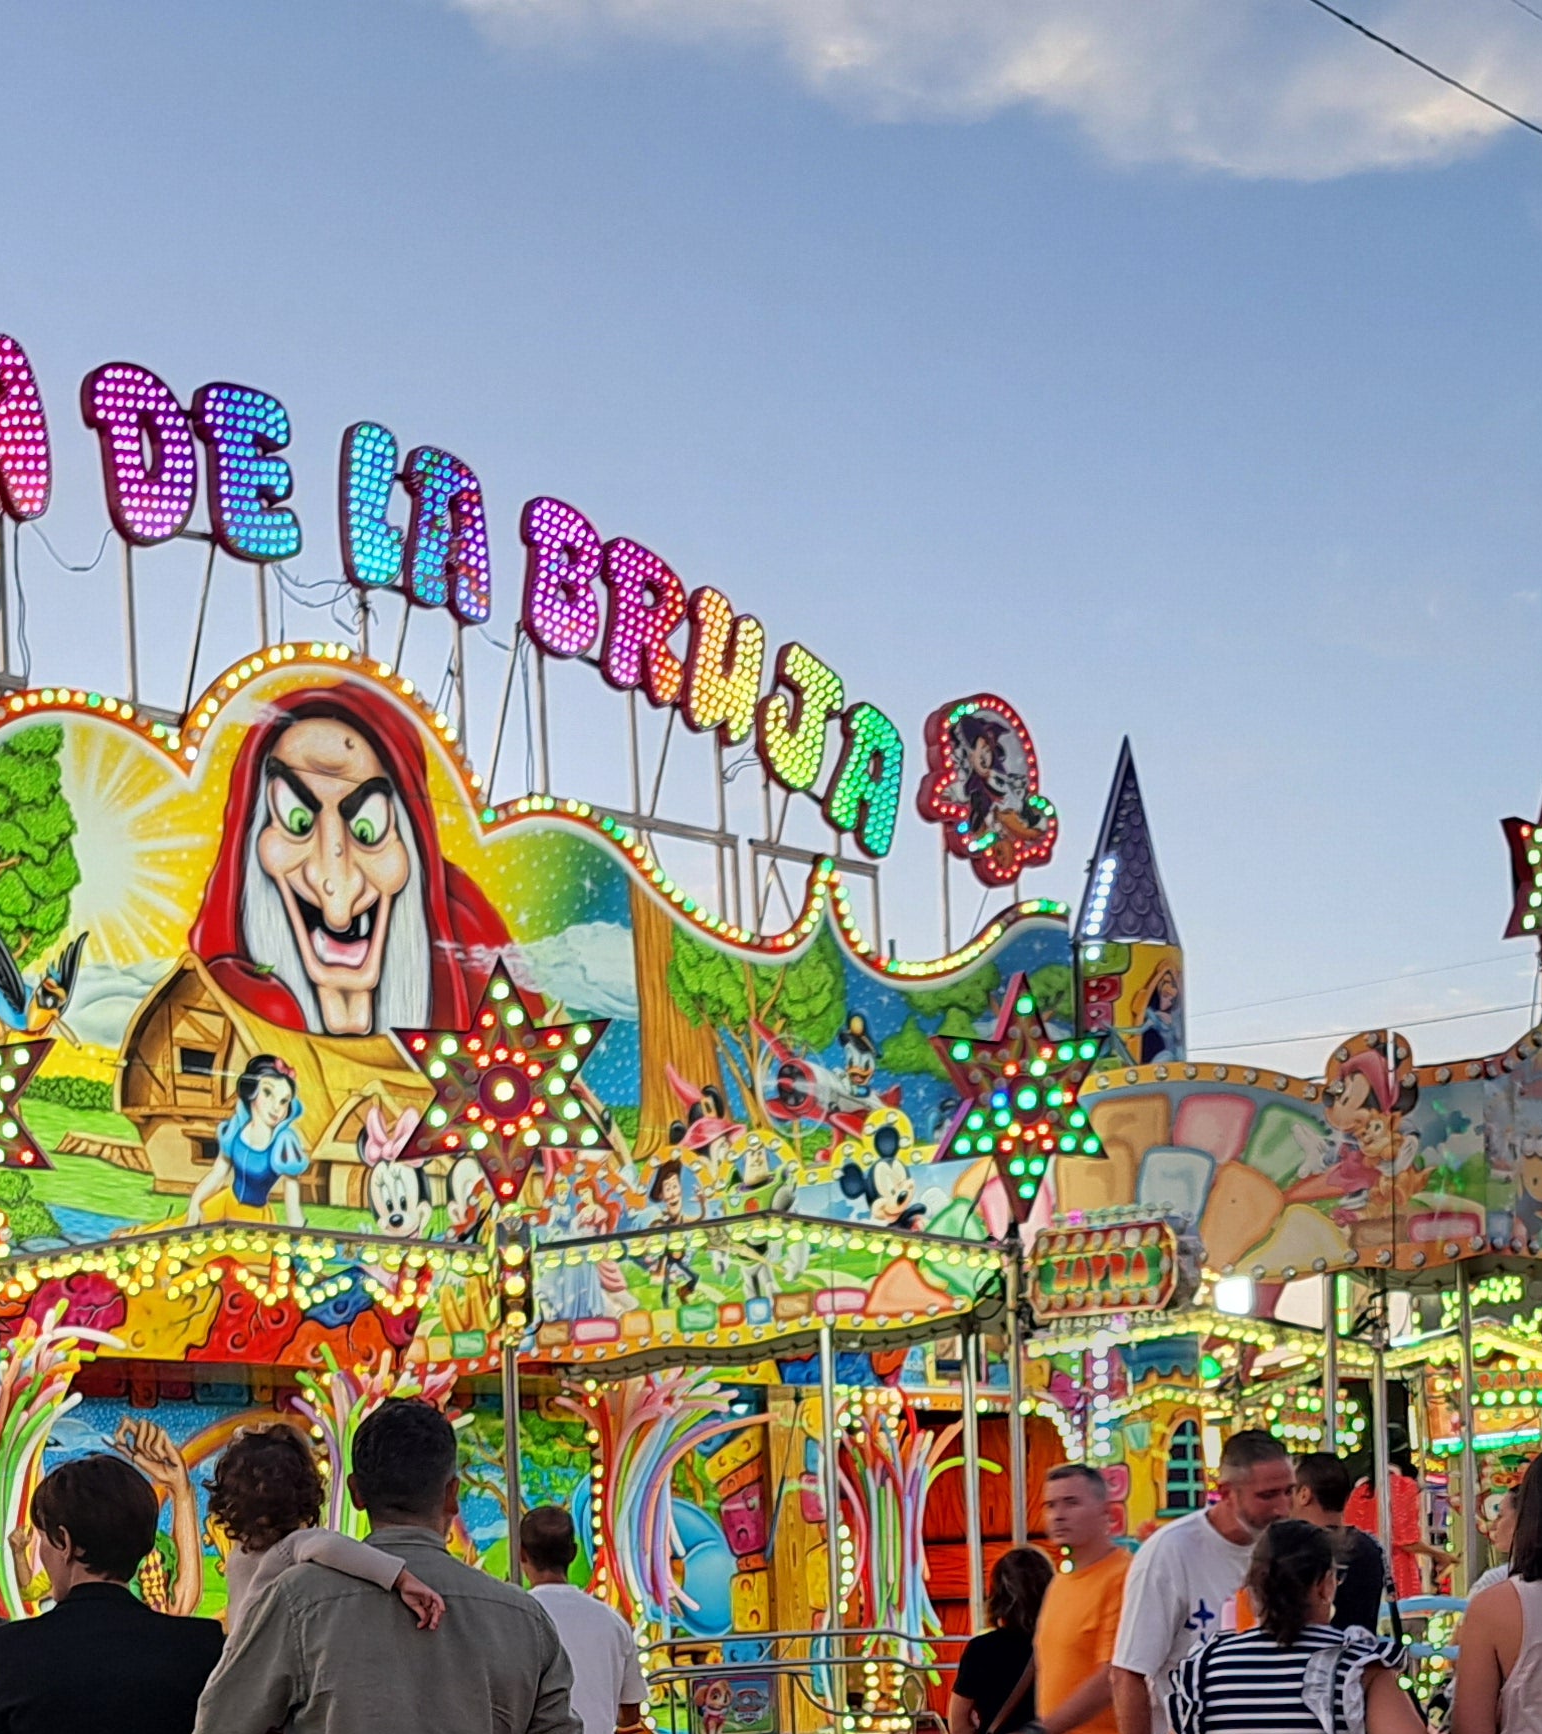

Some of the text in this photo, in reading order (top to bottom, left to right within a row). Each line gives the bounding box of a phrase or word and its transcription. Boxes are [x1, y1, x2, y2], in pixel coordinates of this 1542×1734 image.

[80, 361, 303, 563] DE
[338, 421, 491, 626] LA
[520, 496, 905, 859] BRUJA
[1053, 1248, 1149, 1293] ZAFRA
